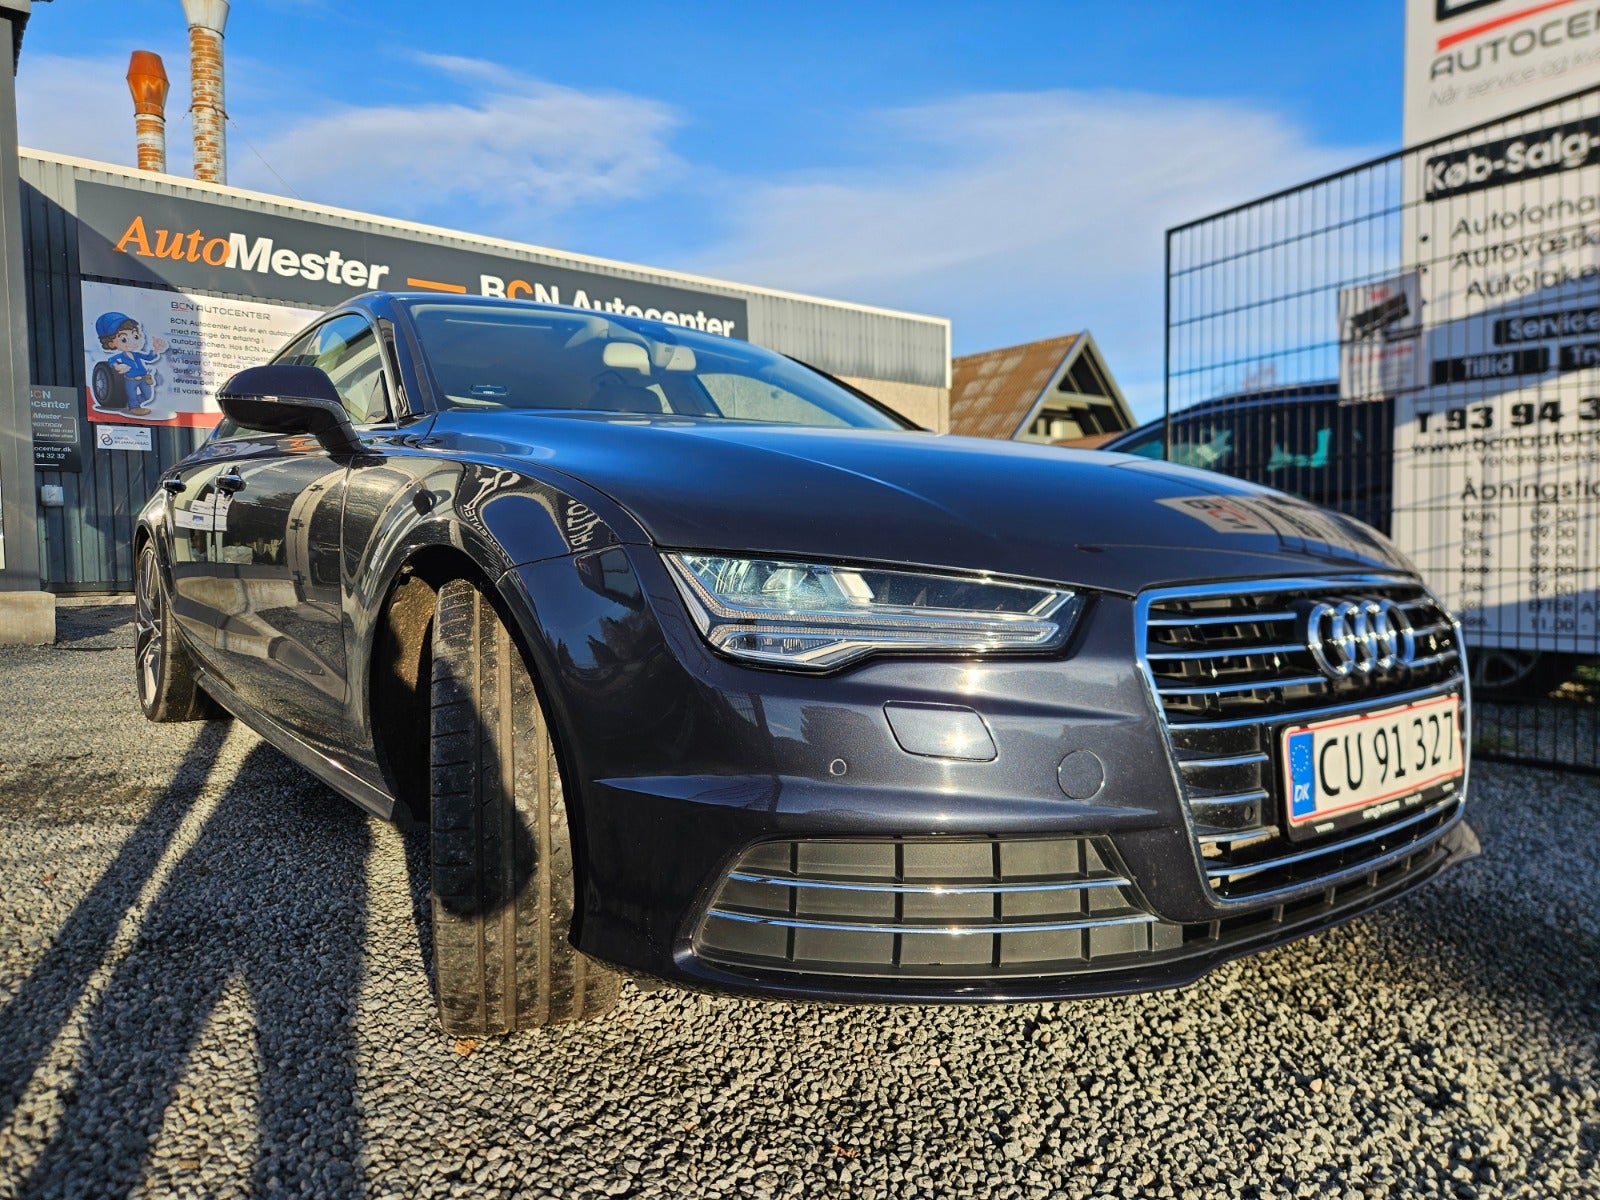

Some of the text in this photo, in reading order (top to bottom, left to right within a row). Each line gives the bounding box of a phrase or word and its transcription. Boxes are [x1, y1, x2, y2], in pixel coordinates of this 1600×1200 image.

[113, 215, 389, 290] AutoMester
[171, 301, 271, 320] BCN AUTOCENTER
[170, 317, 187, 326] BCN
[190, 319, 231, 331] Autocenter
[170, 327, 190, 336] med
[191, 330, 218, 340] mange
[1294, 711, 1453, 803] DK CU 91 327
